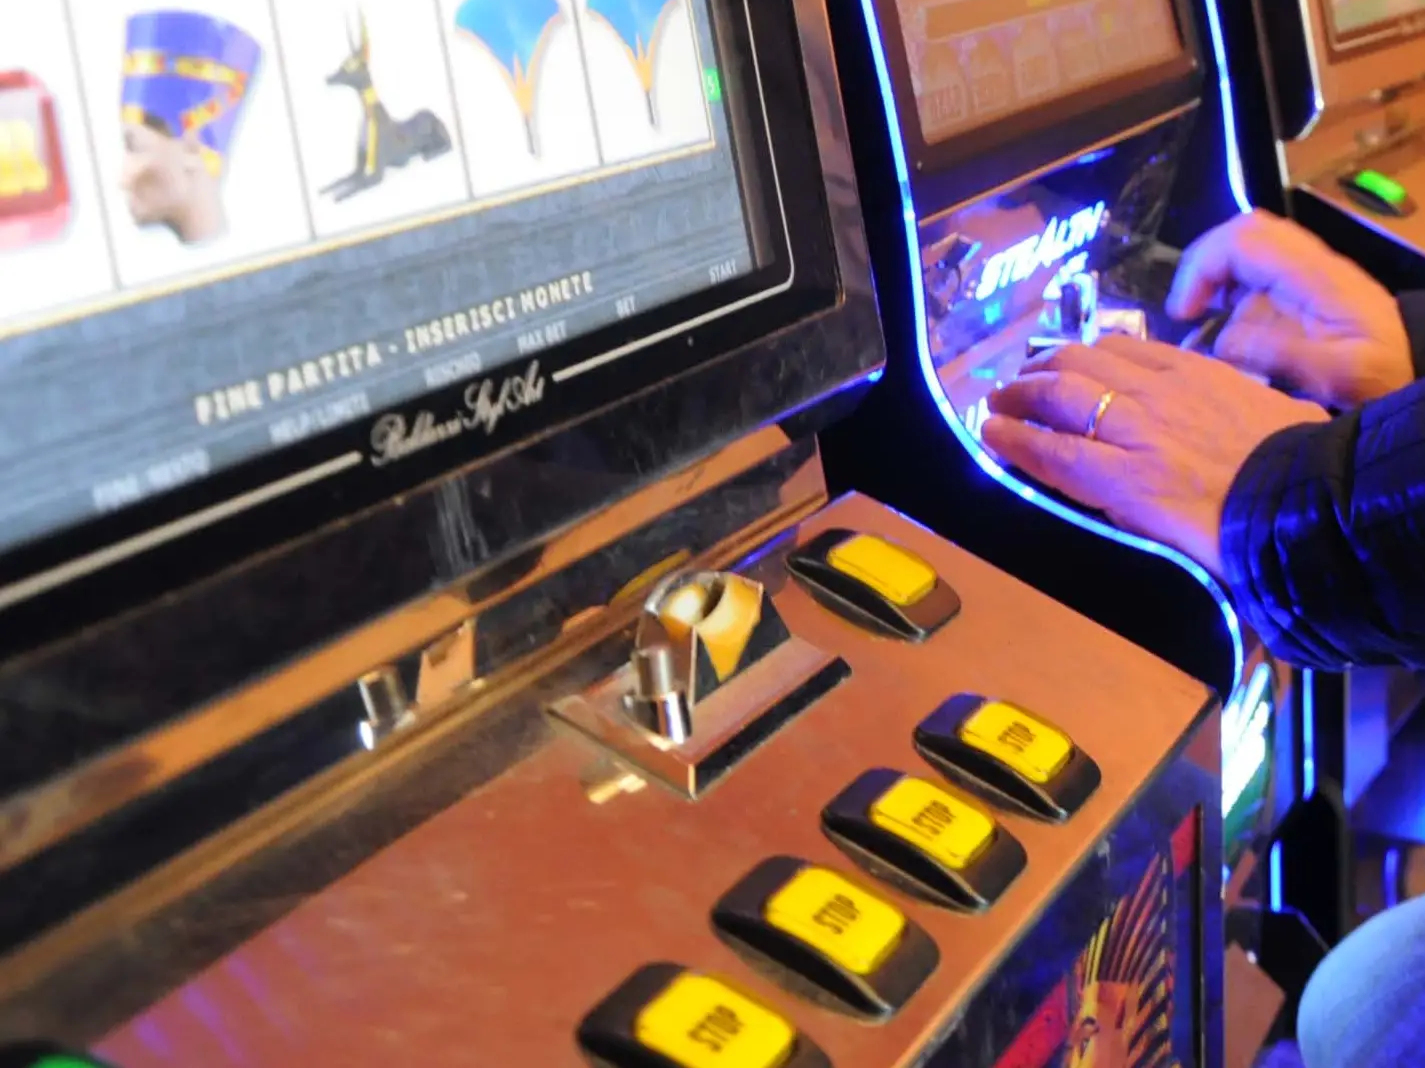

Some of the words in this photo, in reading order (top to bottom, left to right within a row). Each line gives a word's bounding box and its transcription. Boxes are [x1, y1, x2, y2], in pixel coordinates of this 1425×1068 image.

[708, 258, 737, 284] START
[194, 380, 263, 426] FINE
[268, 341, 382, 401] PARTITA
[405, 295, 516, 353] INSERISCI
[521, 270, 594, 313] MONETE
[997, 720, 1037, 754] STOP
[911, 800, 956, 836] STOP
[812, 893, 861, 935] STOP
[687, 1004, 745, 1053] STOP
